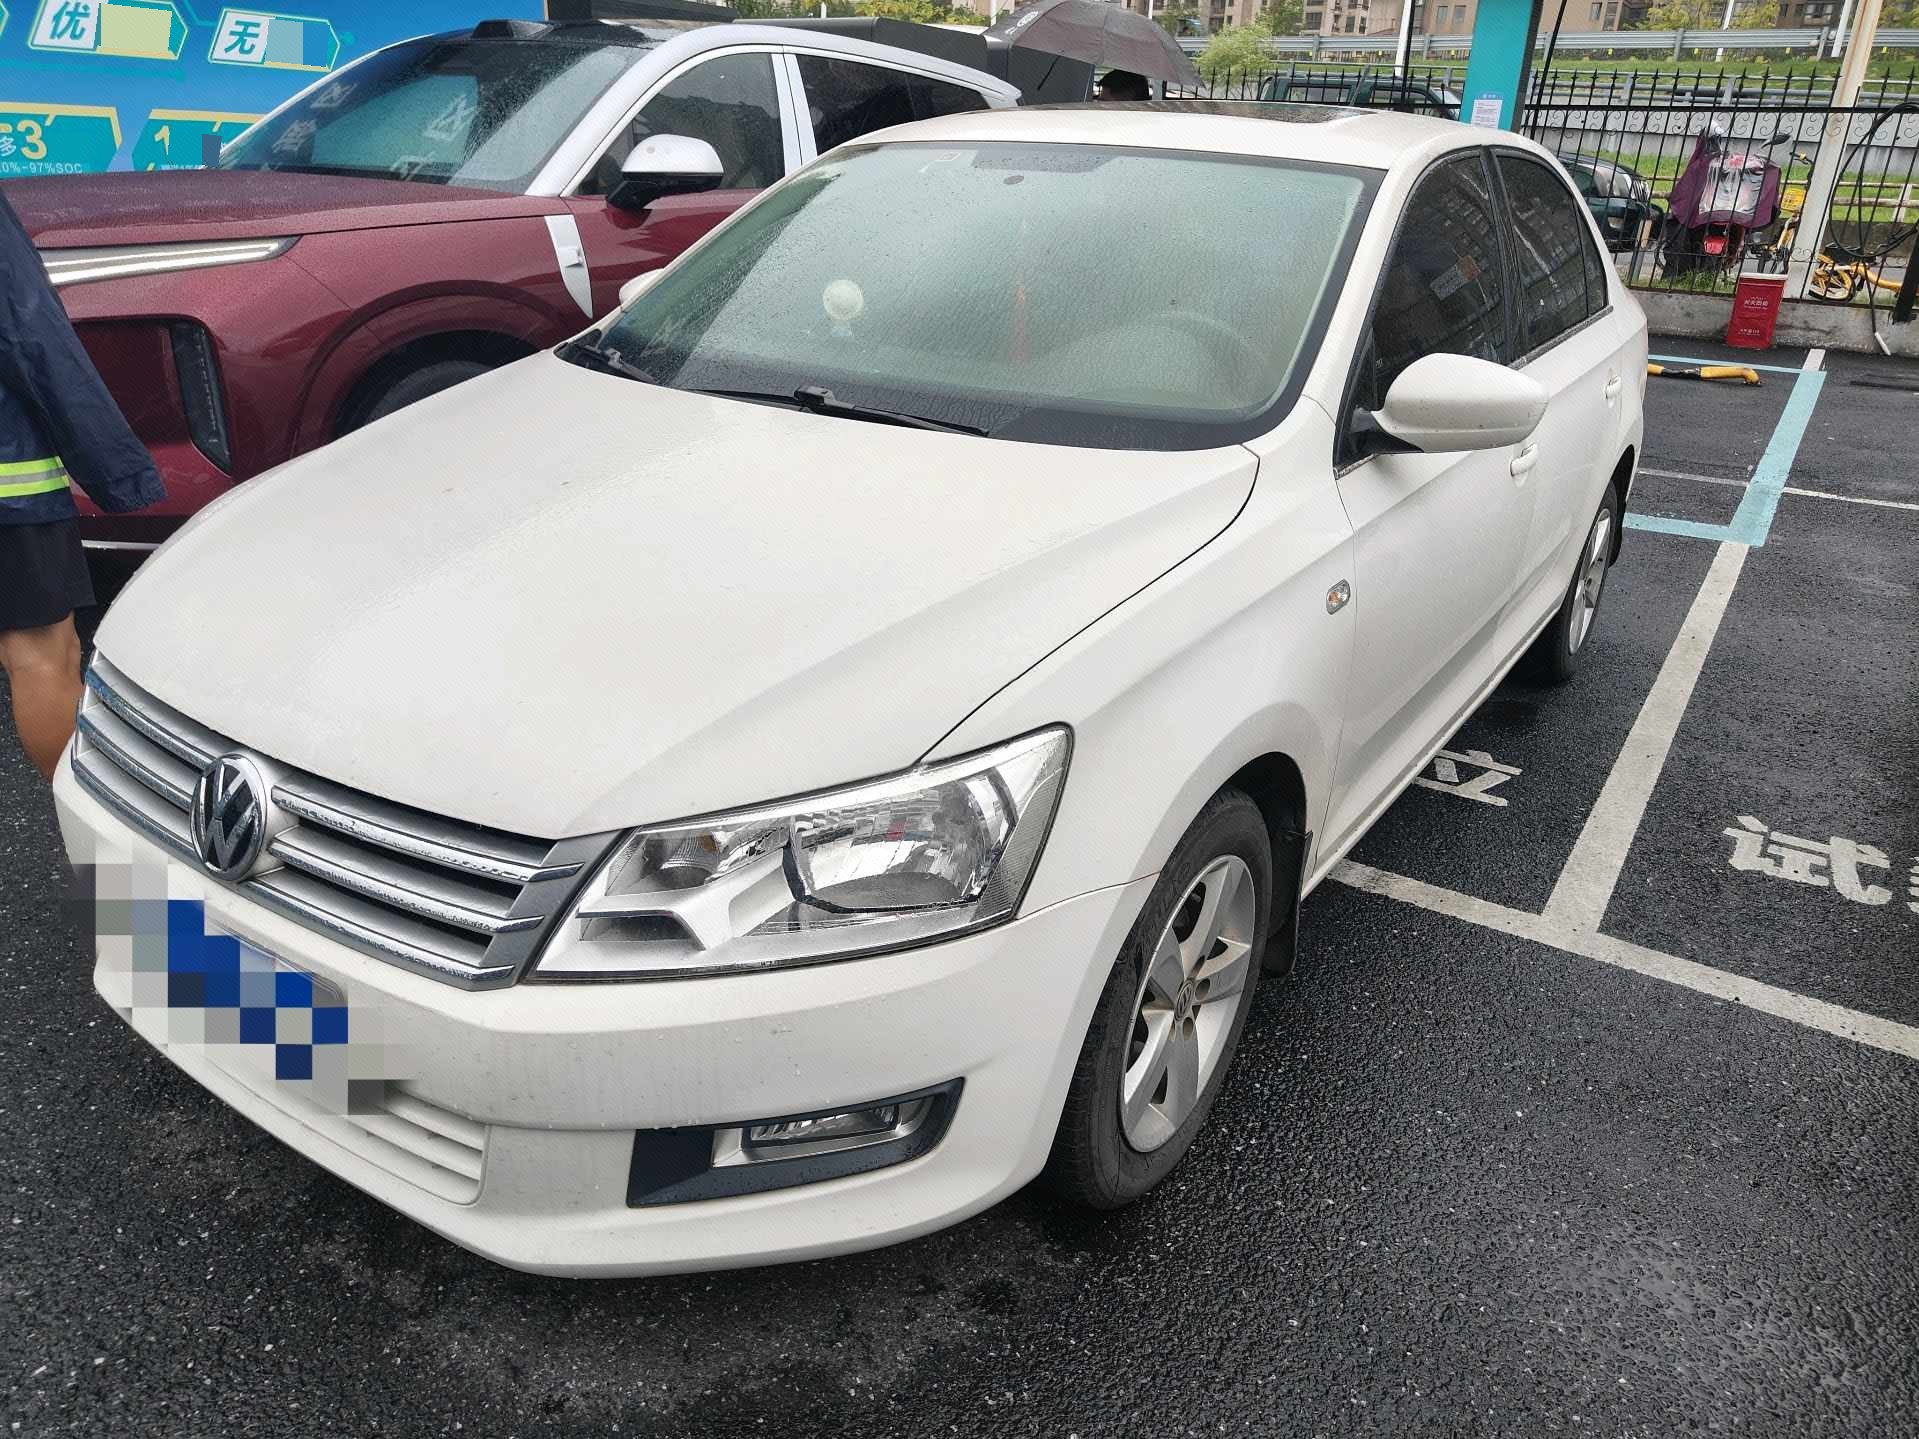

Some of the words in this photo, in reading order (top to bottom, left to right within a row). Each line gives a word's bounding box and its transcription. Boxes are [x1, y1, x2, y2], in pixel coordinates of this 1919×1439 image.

[49, 1, 91, 40] 优
[224, 20, 261, 55] 无
[0, 162, 83, 174] 0%-97%SOC
[1722, 815, 1919, 914] 试
